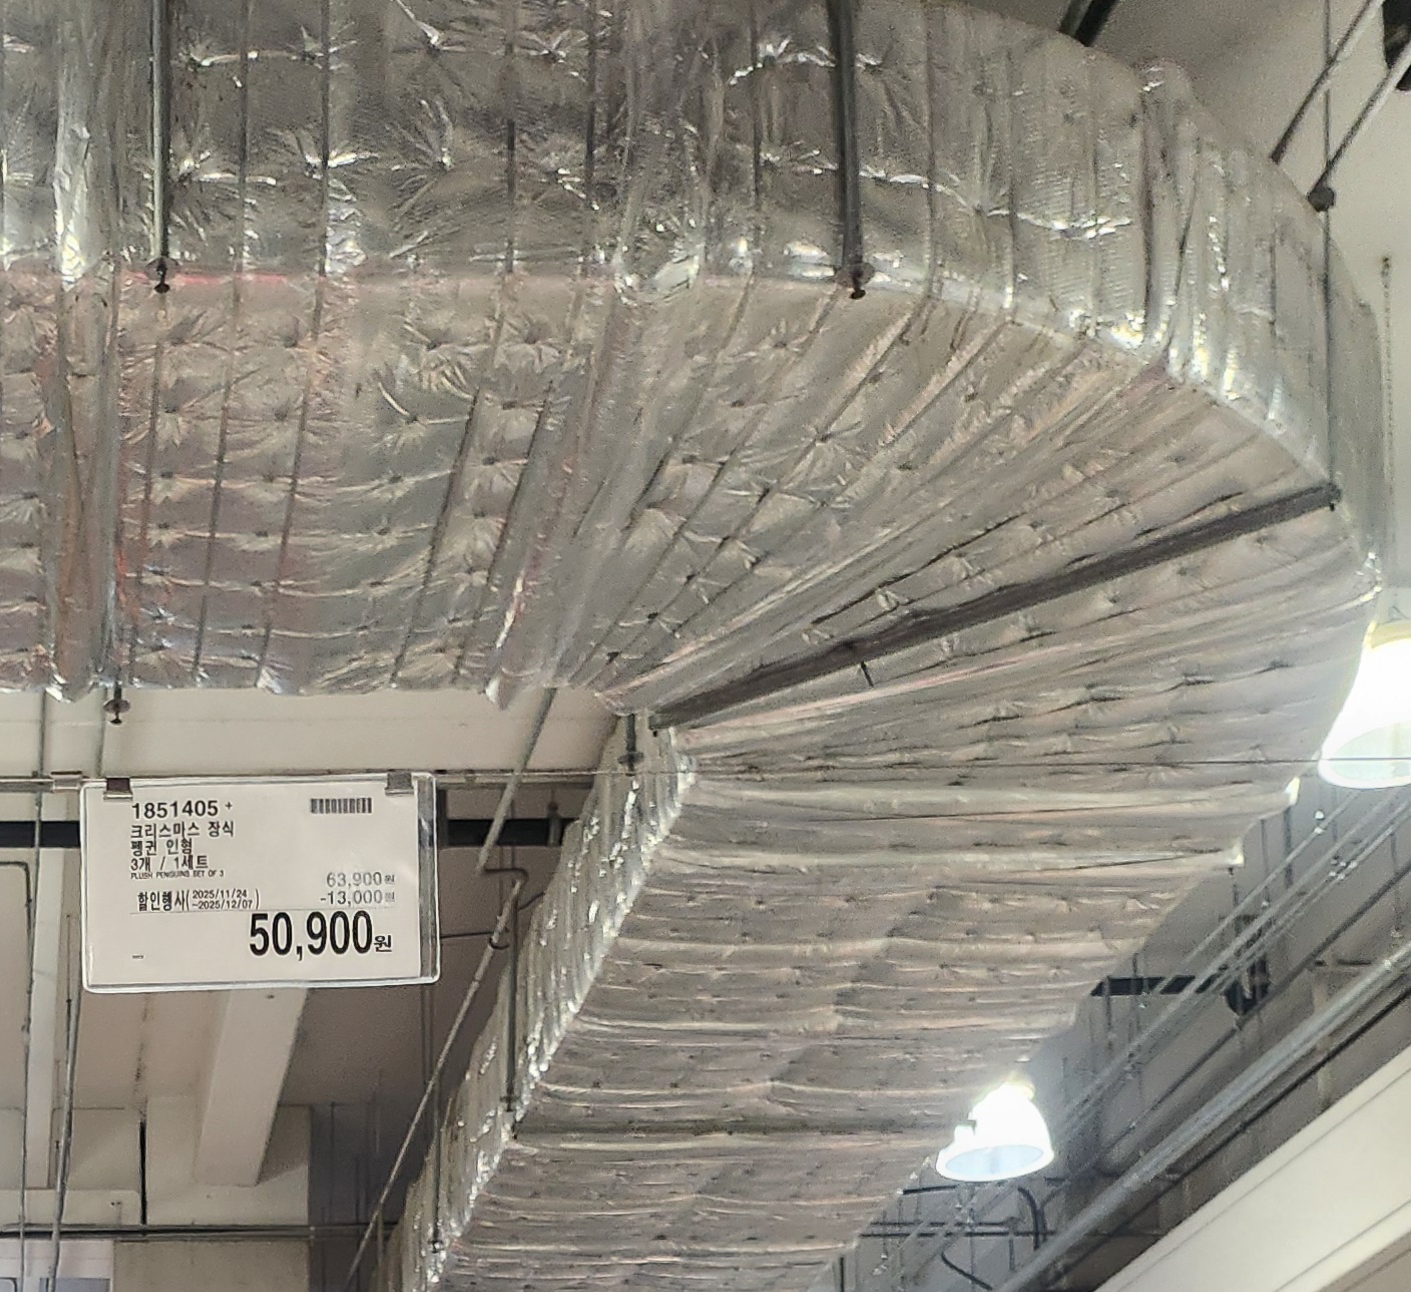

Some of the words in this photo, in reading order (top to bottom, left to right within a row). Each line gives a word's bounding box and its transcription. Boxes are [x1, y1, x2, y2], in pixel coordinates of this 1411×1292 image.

[132, 800, 218, 819] 1851405
[130, 821, 200, 839] 크리스마스
[208, 820, 234, 837] 장식
[166, 837, 193, 855] 인형
[130, 856, 150, 872] 3개
[160, 856, 166, 870] /
[174, 855, 208, 871] 1세트
[192, 888, 248, 899] 2025/11/24
[250, 911, 391, 961] 50,900원
